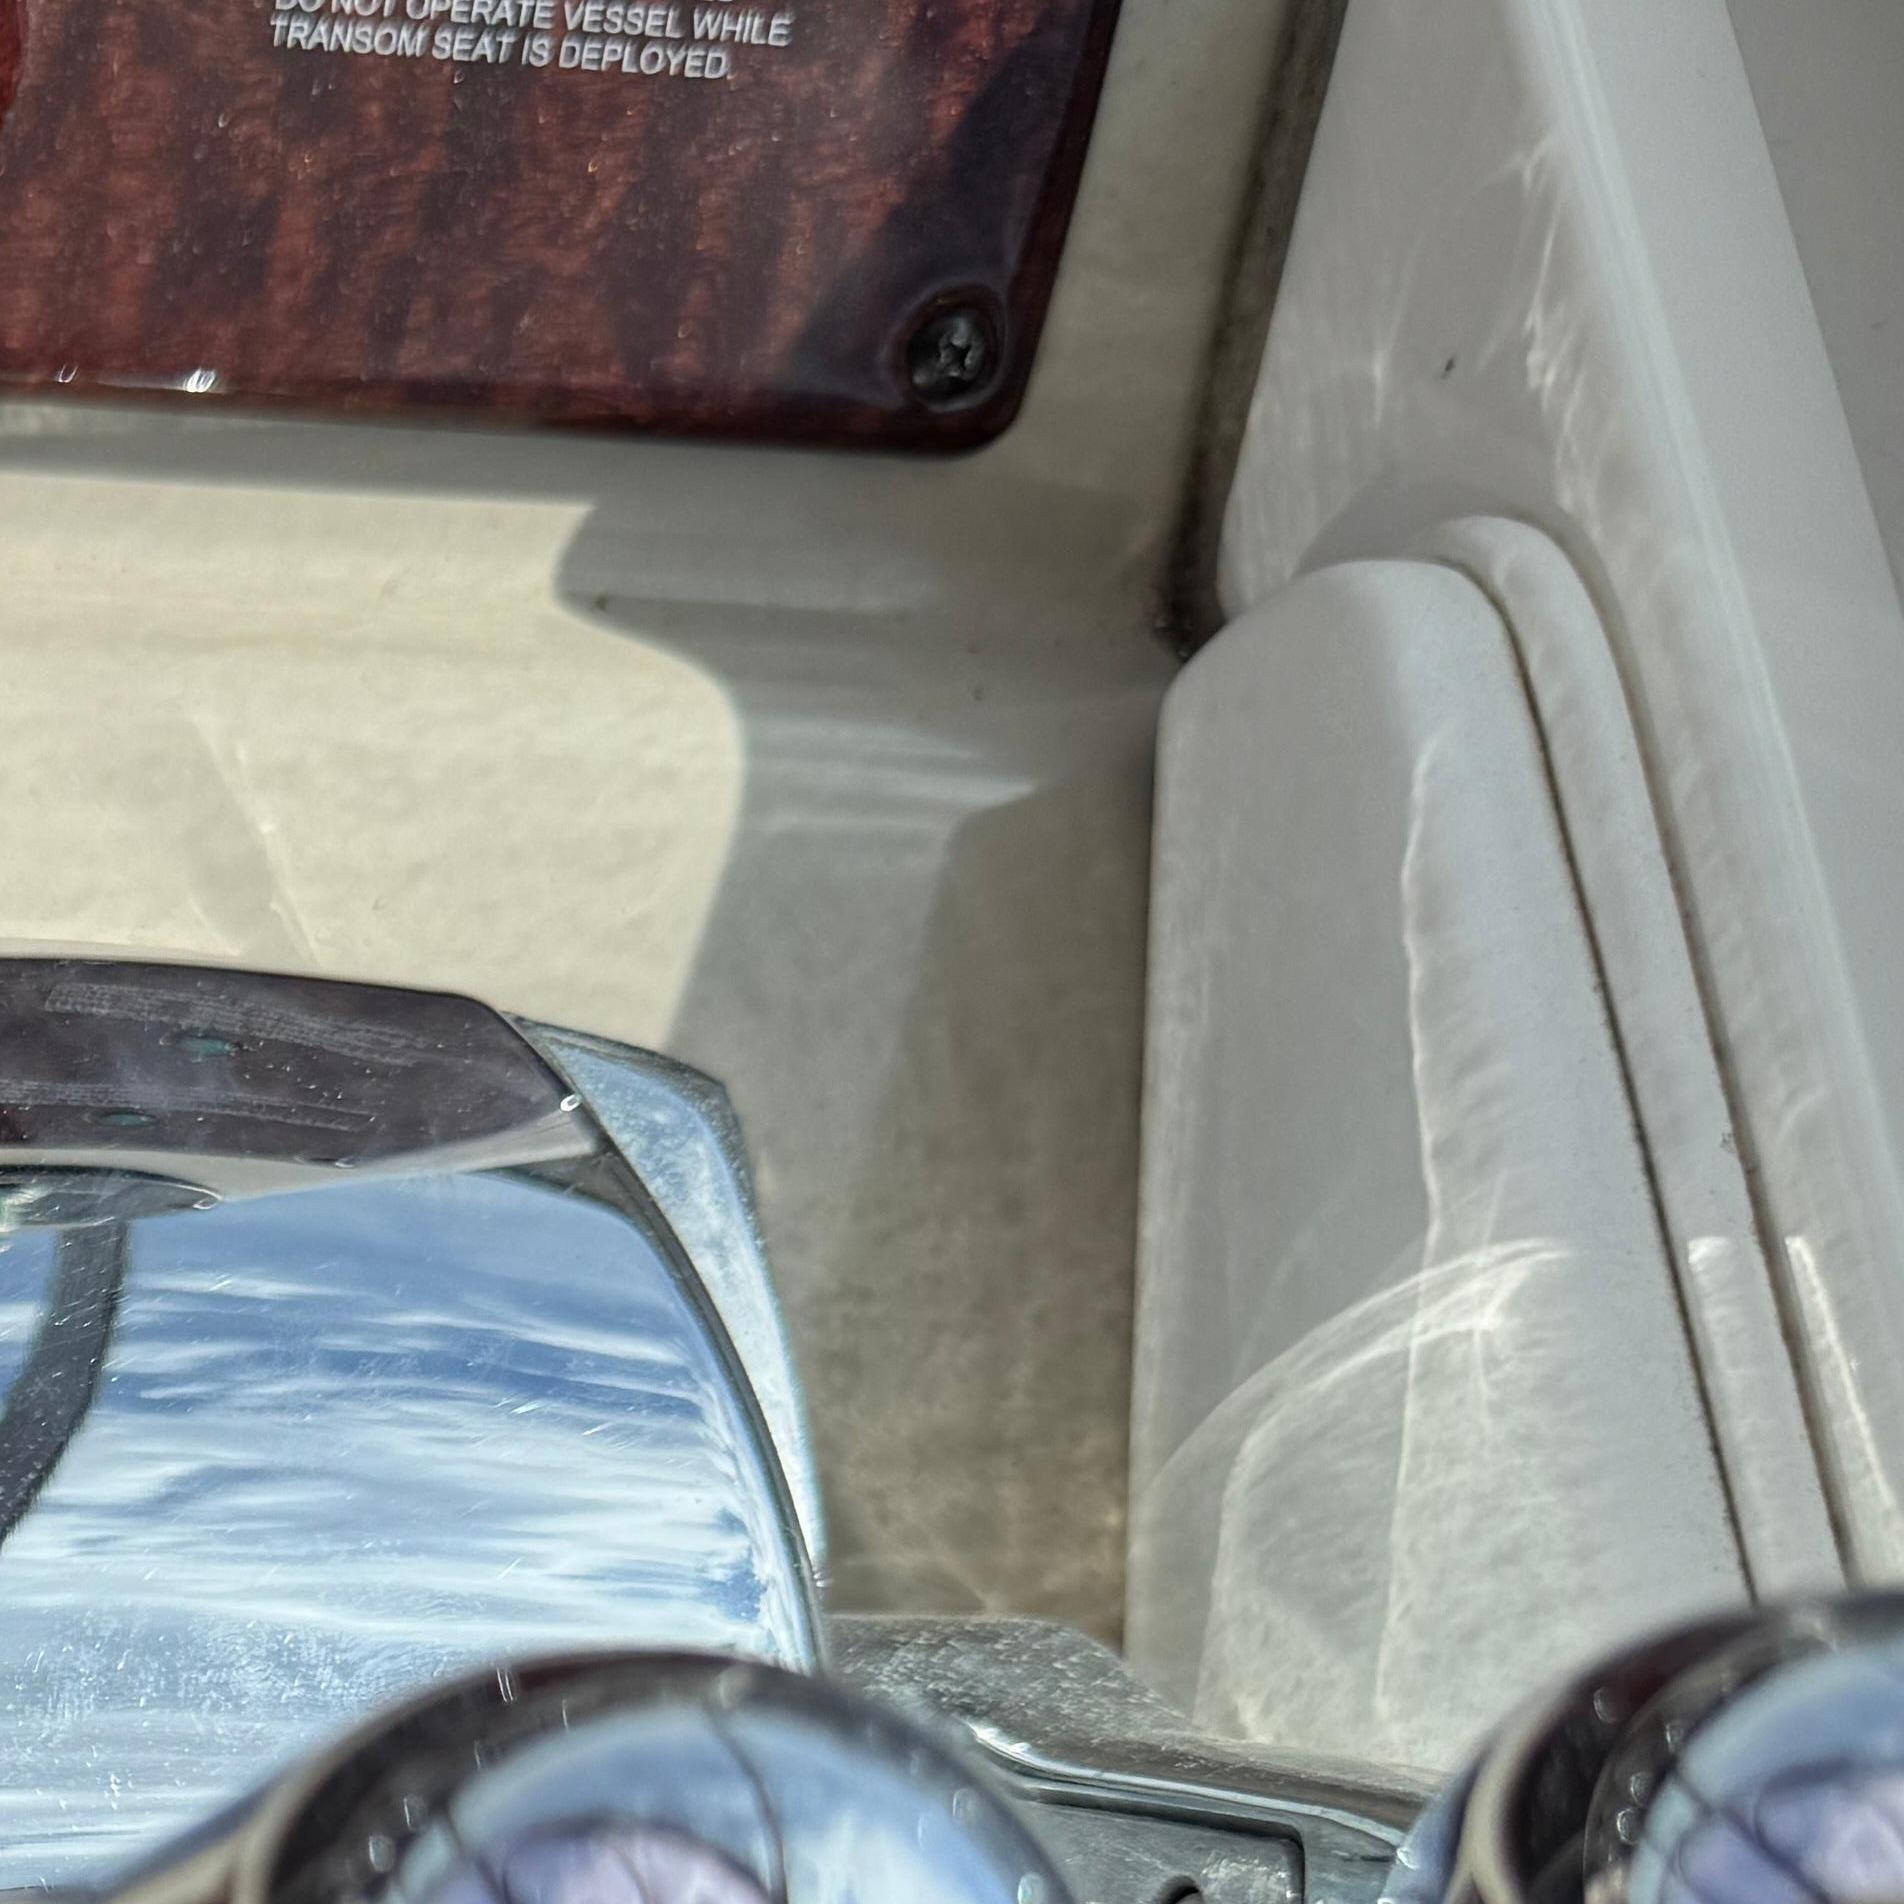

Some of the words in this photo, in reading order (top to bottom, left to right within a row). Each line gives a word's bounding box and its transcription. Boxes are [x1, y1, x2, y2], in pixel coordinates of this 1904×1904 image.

[270, 11, 429, 57] TRANSOM
[432, 23, 519, 63] SEAT
[521, 32, 554, 67] IS
[559, 34, 733, 80] DEPLOYED.
[406, 0, 554, 29] OPERATE
[564, 2, 684, 38] VESSEL
[692, 7, 796, 46] WHILE
